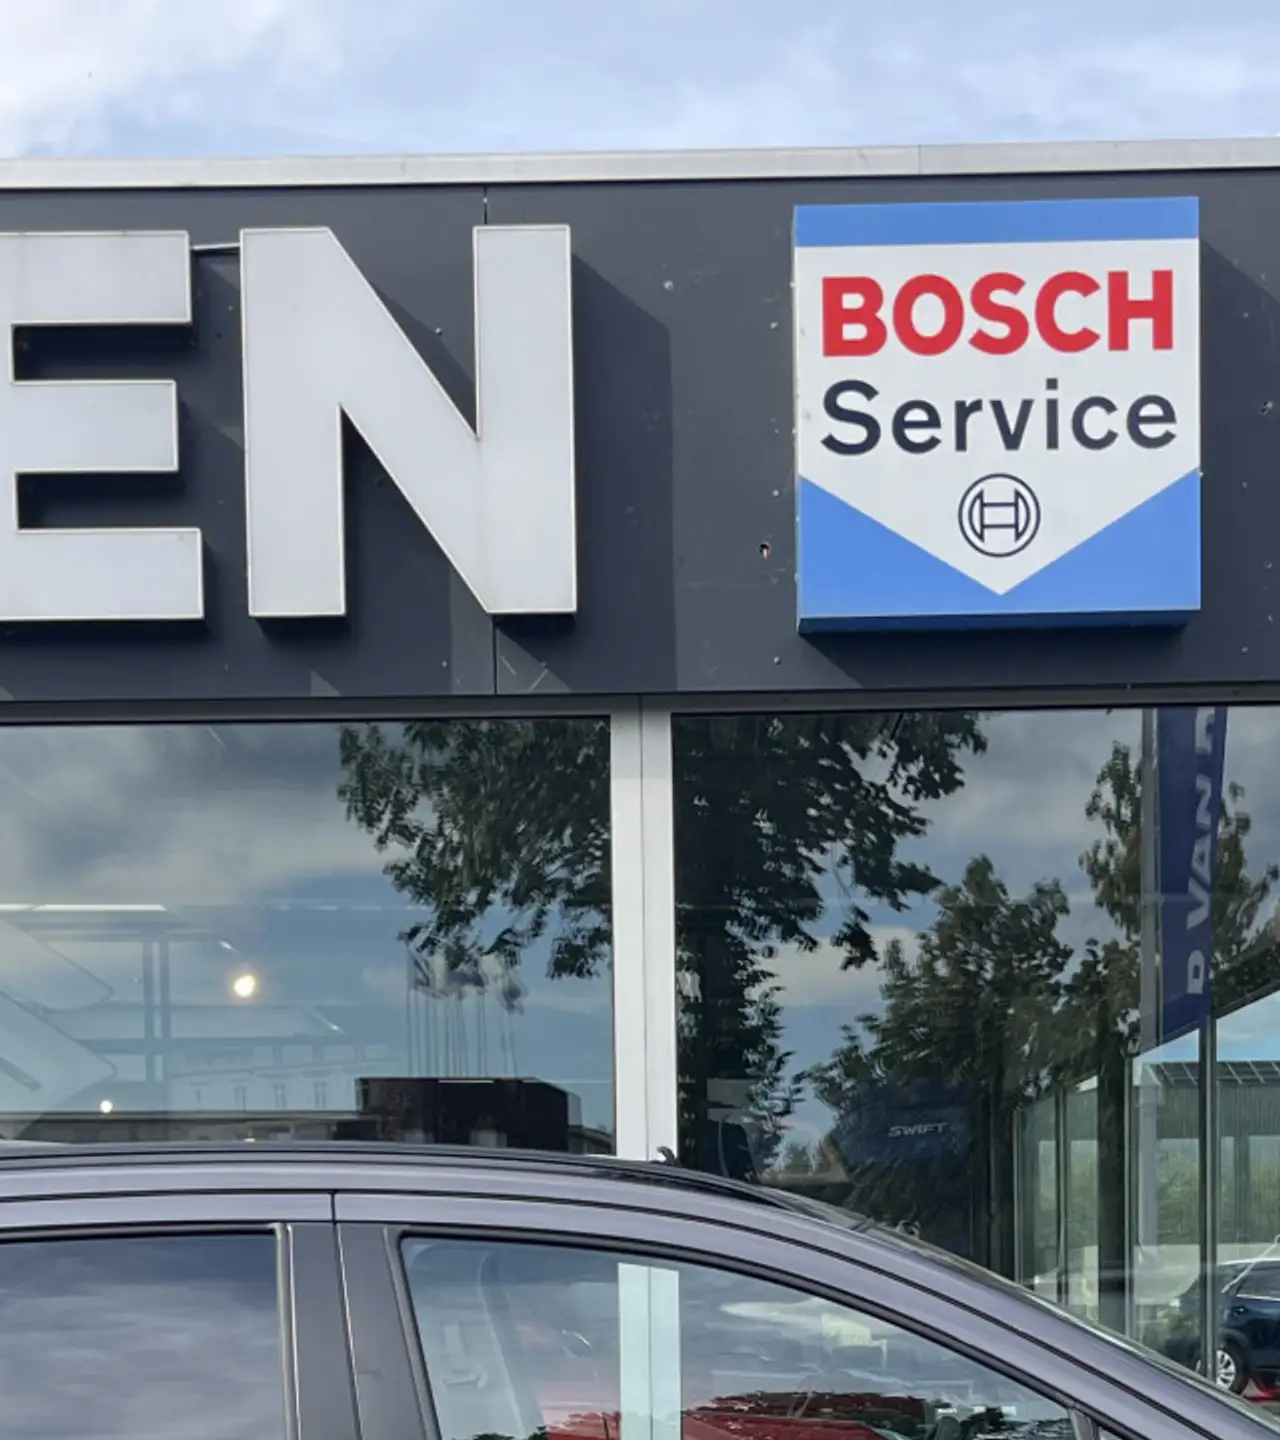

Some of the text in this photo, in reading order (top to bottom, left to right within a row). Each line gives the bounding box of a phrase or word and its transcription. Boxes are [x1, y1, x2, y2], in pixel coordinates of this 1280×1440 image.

[821, 269, 1175, 357] BOSCH
[820, 377, 1178, 457] Service
[888, 1122, 948, 1138] SWIFT
